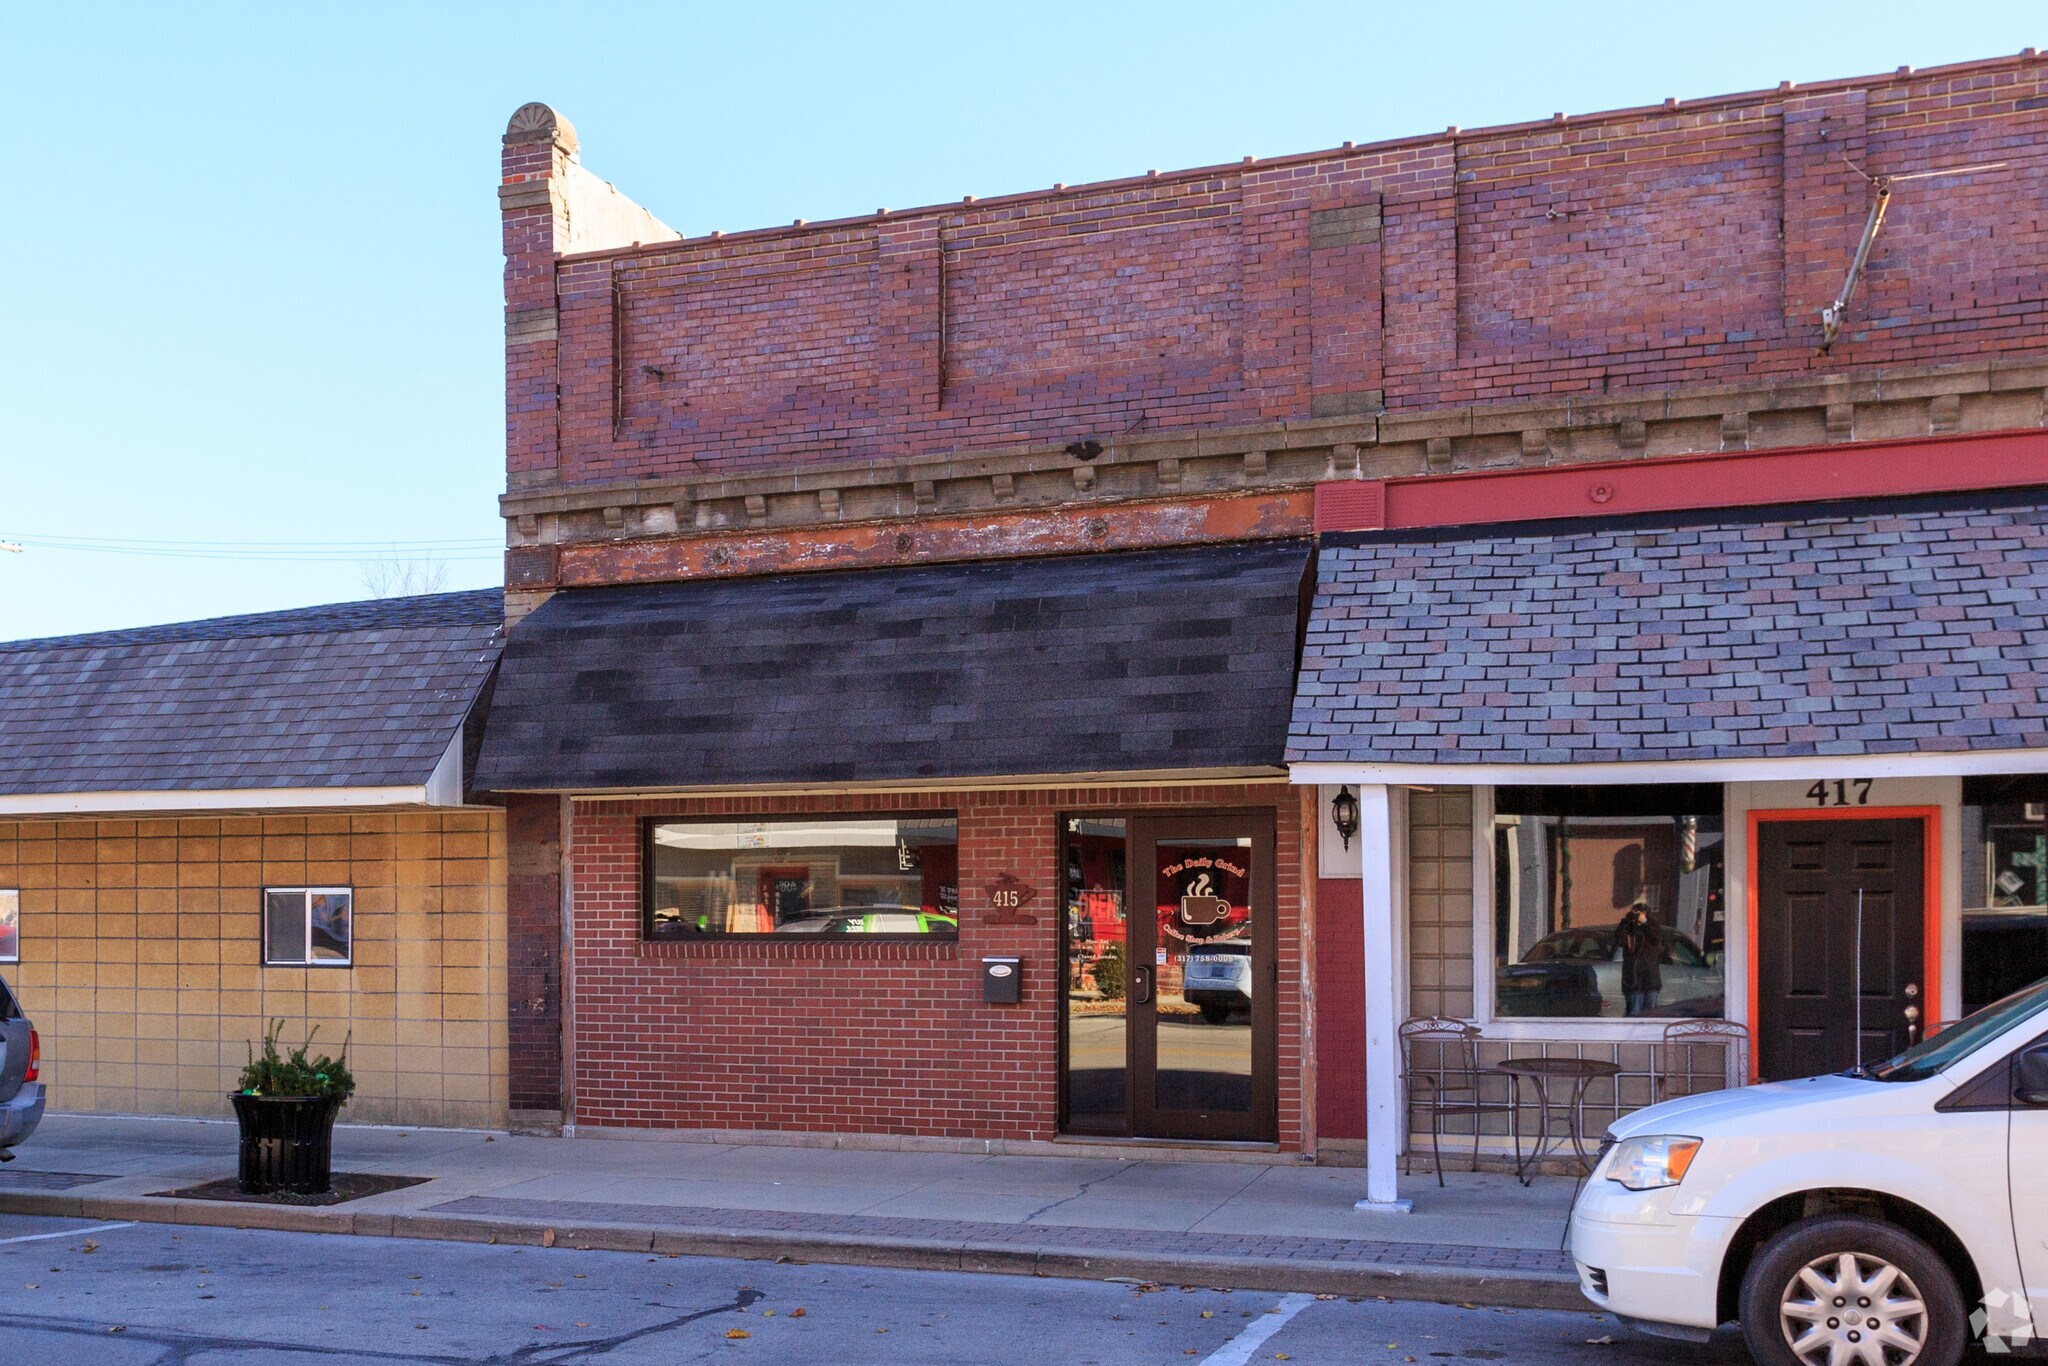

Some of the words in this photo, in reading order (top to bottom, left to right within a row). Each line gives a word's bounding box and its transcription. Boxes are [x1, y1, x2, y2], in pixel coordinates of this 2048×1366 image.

[1806, 777, 1874, 806] 417
[1162, 863, 1183, 877] The
[1184, 857, 1213, 868] Daily
[1215, 859, 1246, 877] Grind
[993, 891, 1018, 907] 415
[1079, 892, 1117, 918] OPEN
[1205, 936, 1213, 944] &
[1174, 954, 1194, 962] (317)
